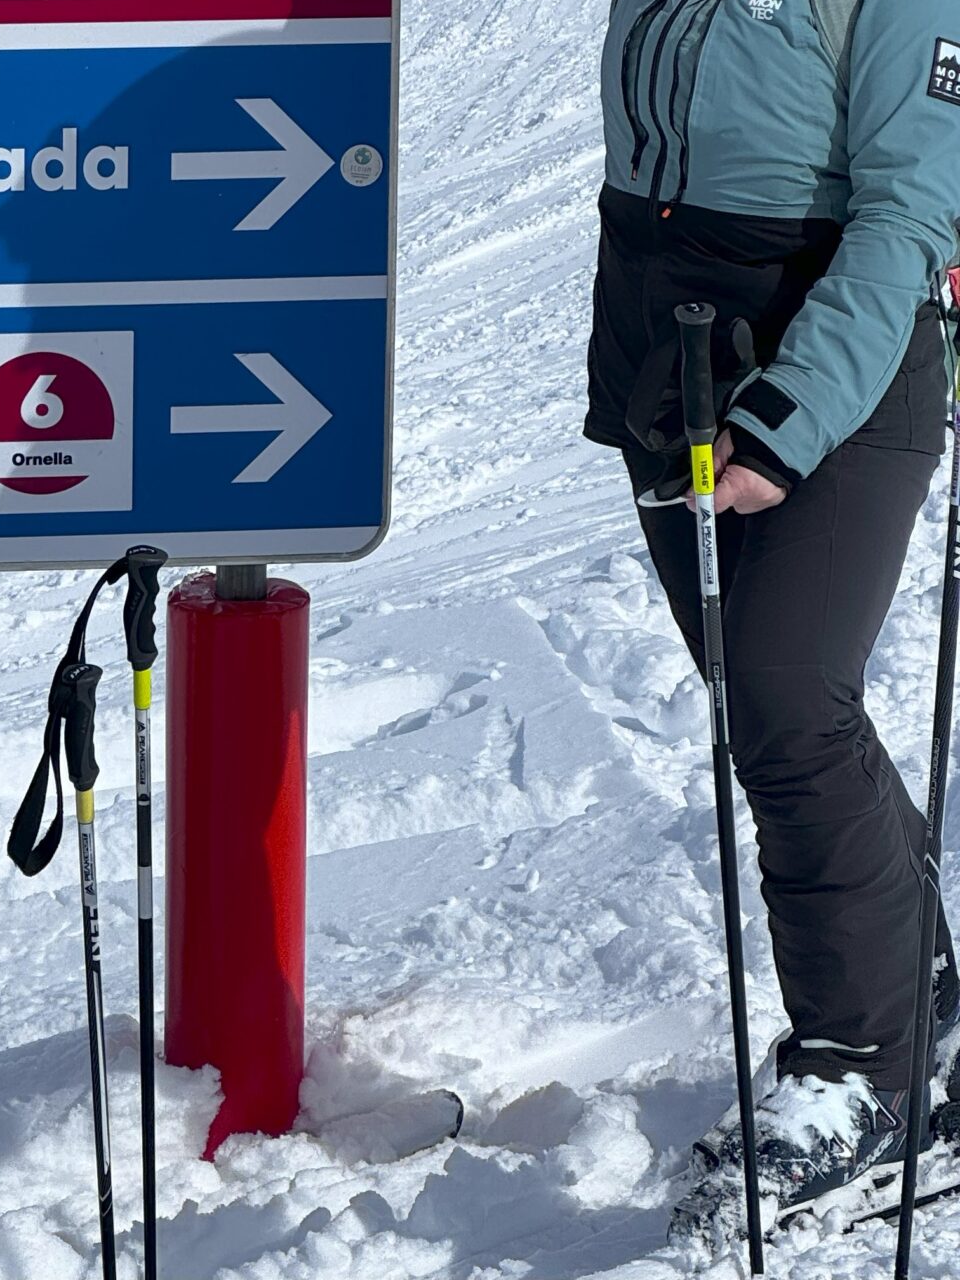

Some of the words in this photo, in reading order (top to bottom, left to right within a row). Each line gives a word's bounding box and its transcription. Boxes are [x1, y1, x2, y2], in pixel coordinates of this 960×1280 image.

[750, 6, 774, 21] TEC
[20, 374, 64, 429] 6
[12, 452, 73, 467] Ornella
